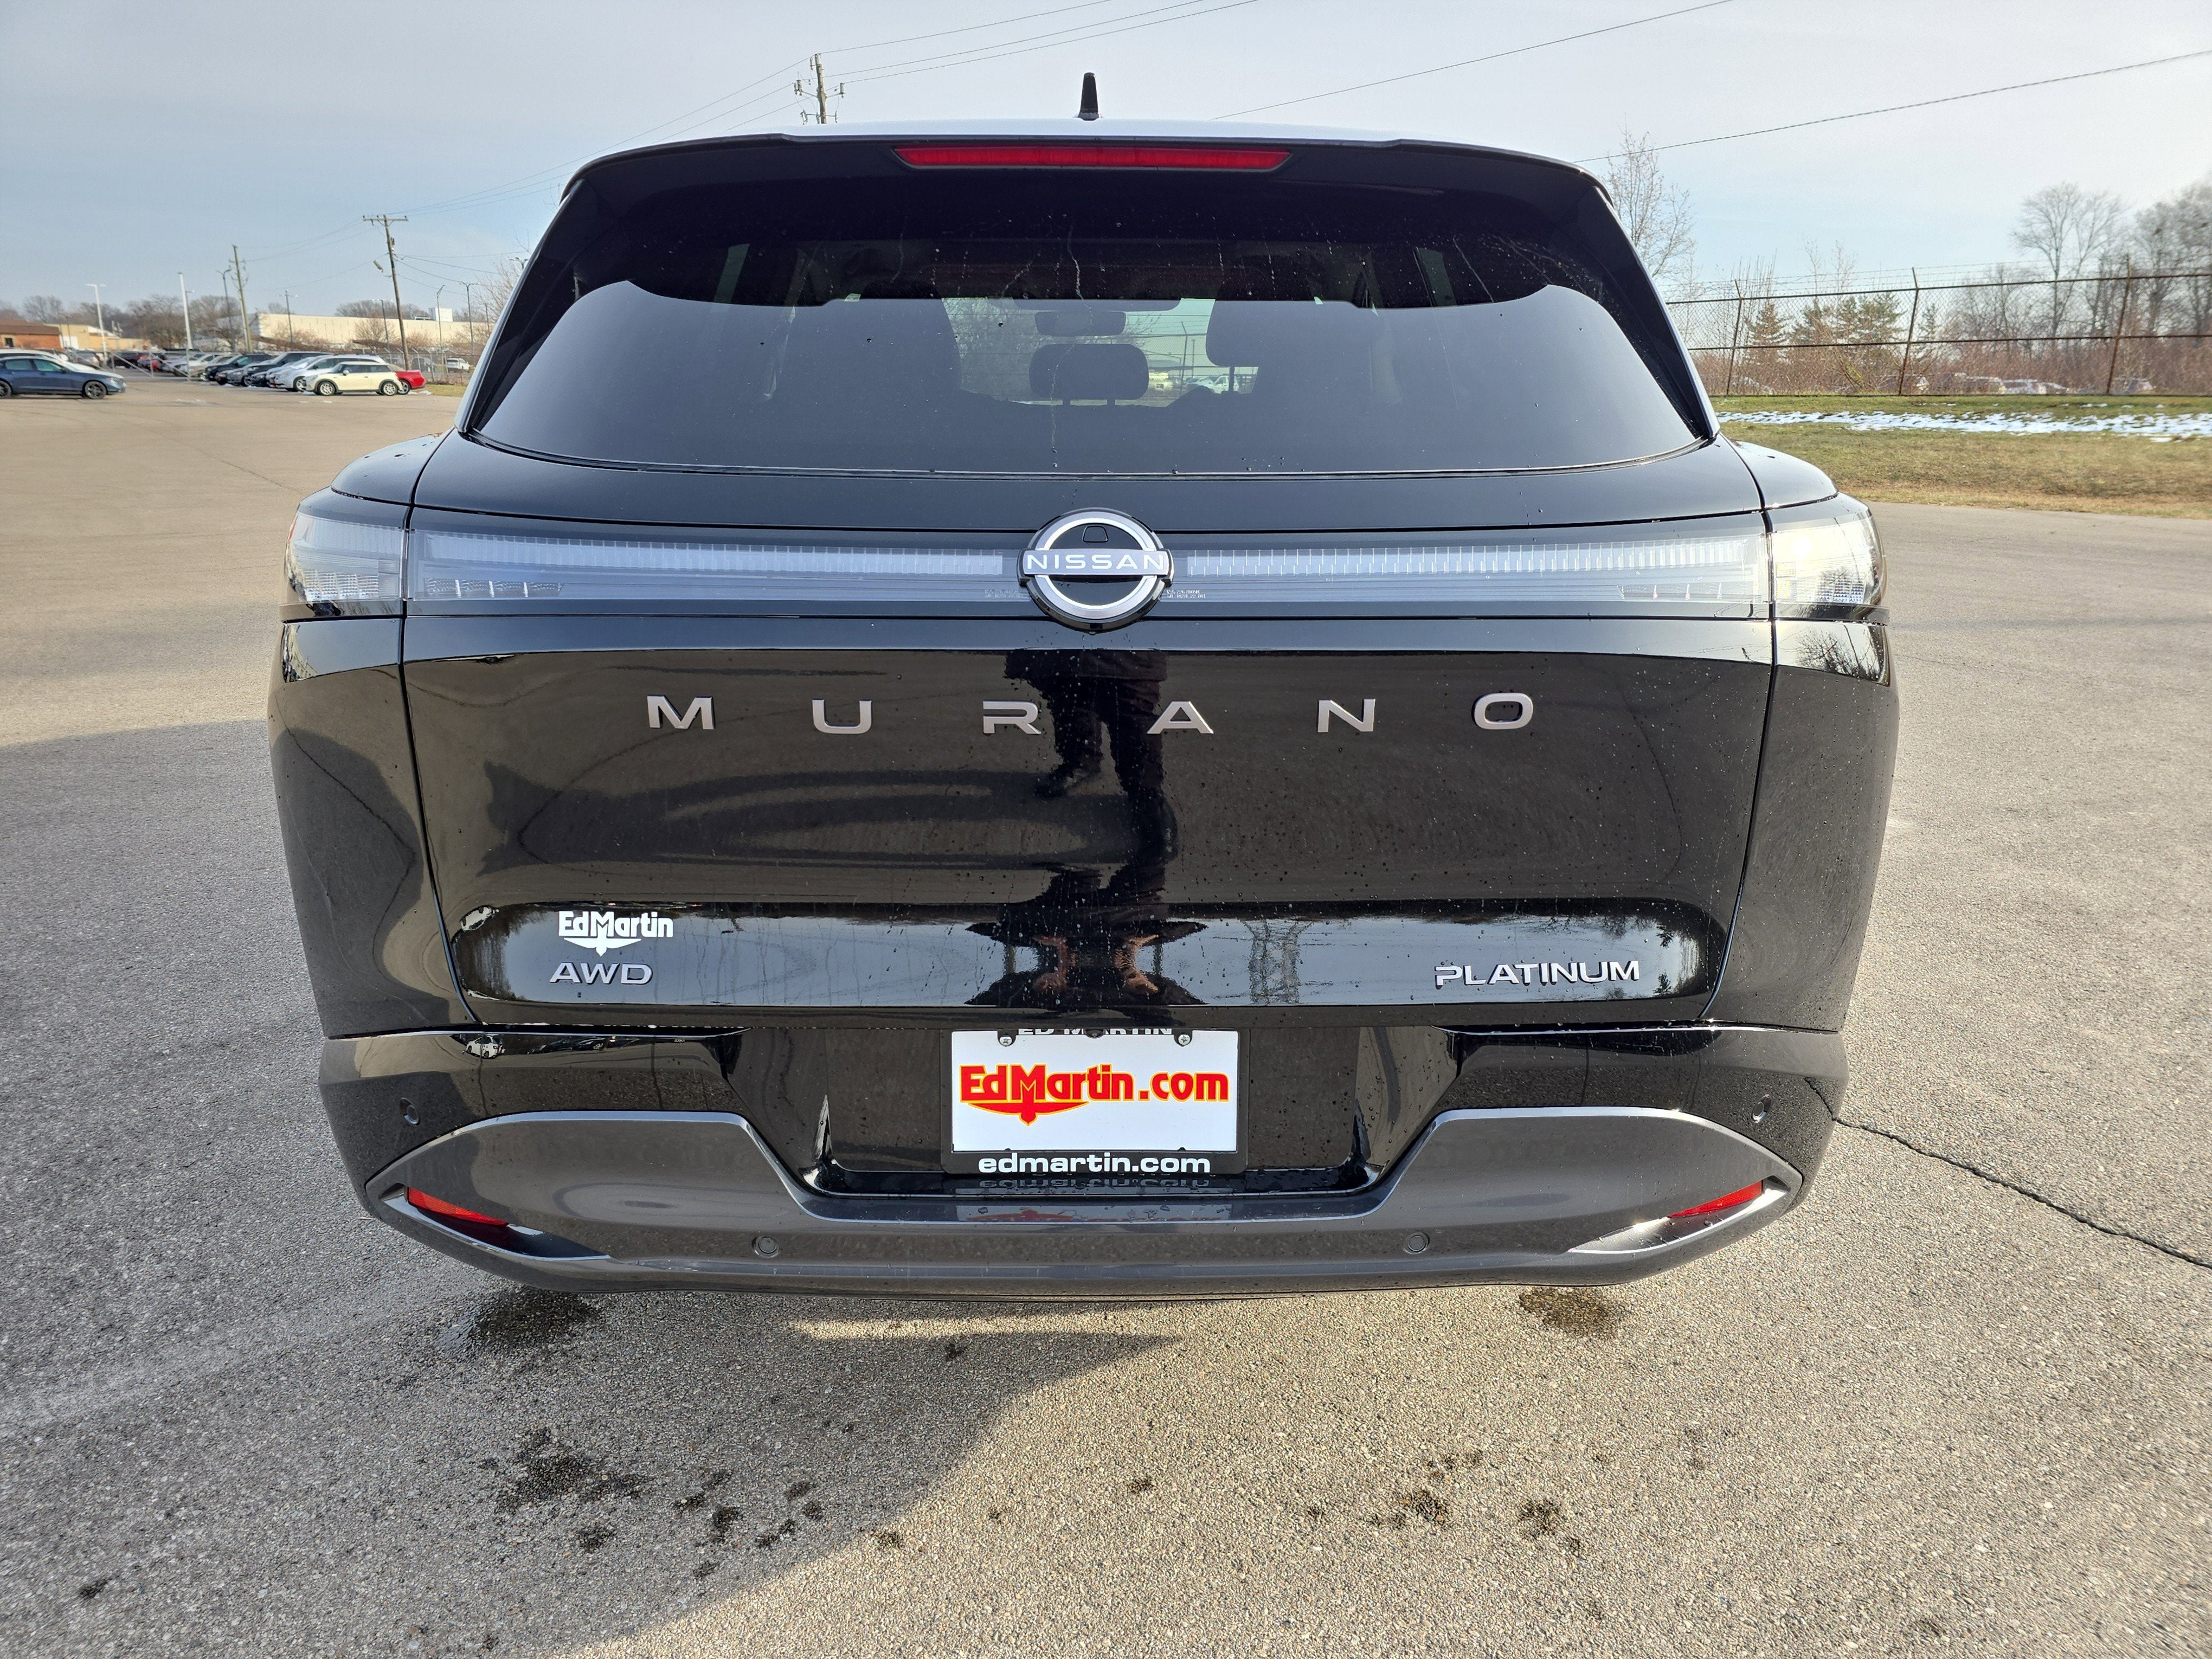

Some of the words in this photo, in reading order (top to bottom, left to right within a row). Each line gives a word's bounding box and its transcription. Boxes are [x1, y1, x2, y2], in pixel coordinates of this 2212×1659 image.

[1026, 554, 1166, 570] NISSAN
[647, 692, 1534, 735] MURANO
[558, 910, 674, 938] EdMartin
[549, 962, 653, 985] AWD
[1434, 960, 1640, 990] PLATINUM
[959, 1064, 1229, 1103] EdMartin.com
[978, 1152, 1211, 1173] edmartin.com
